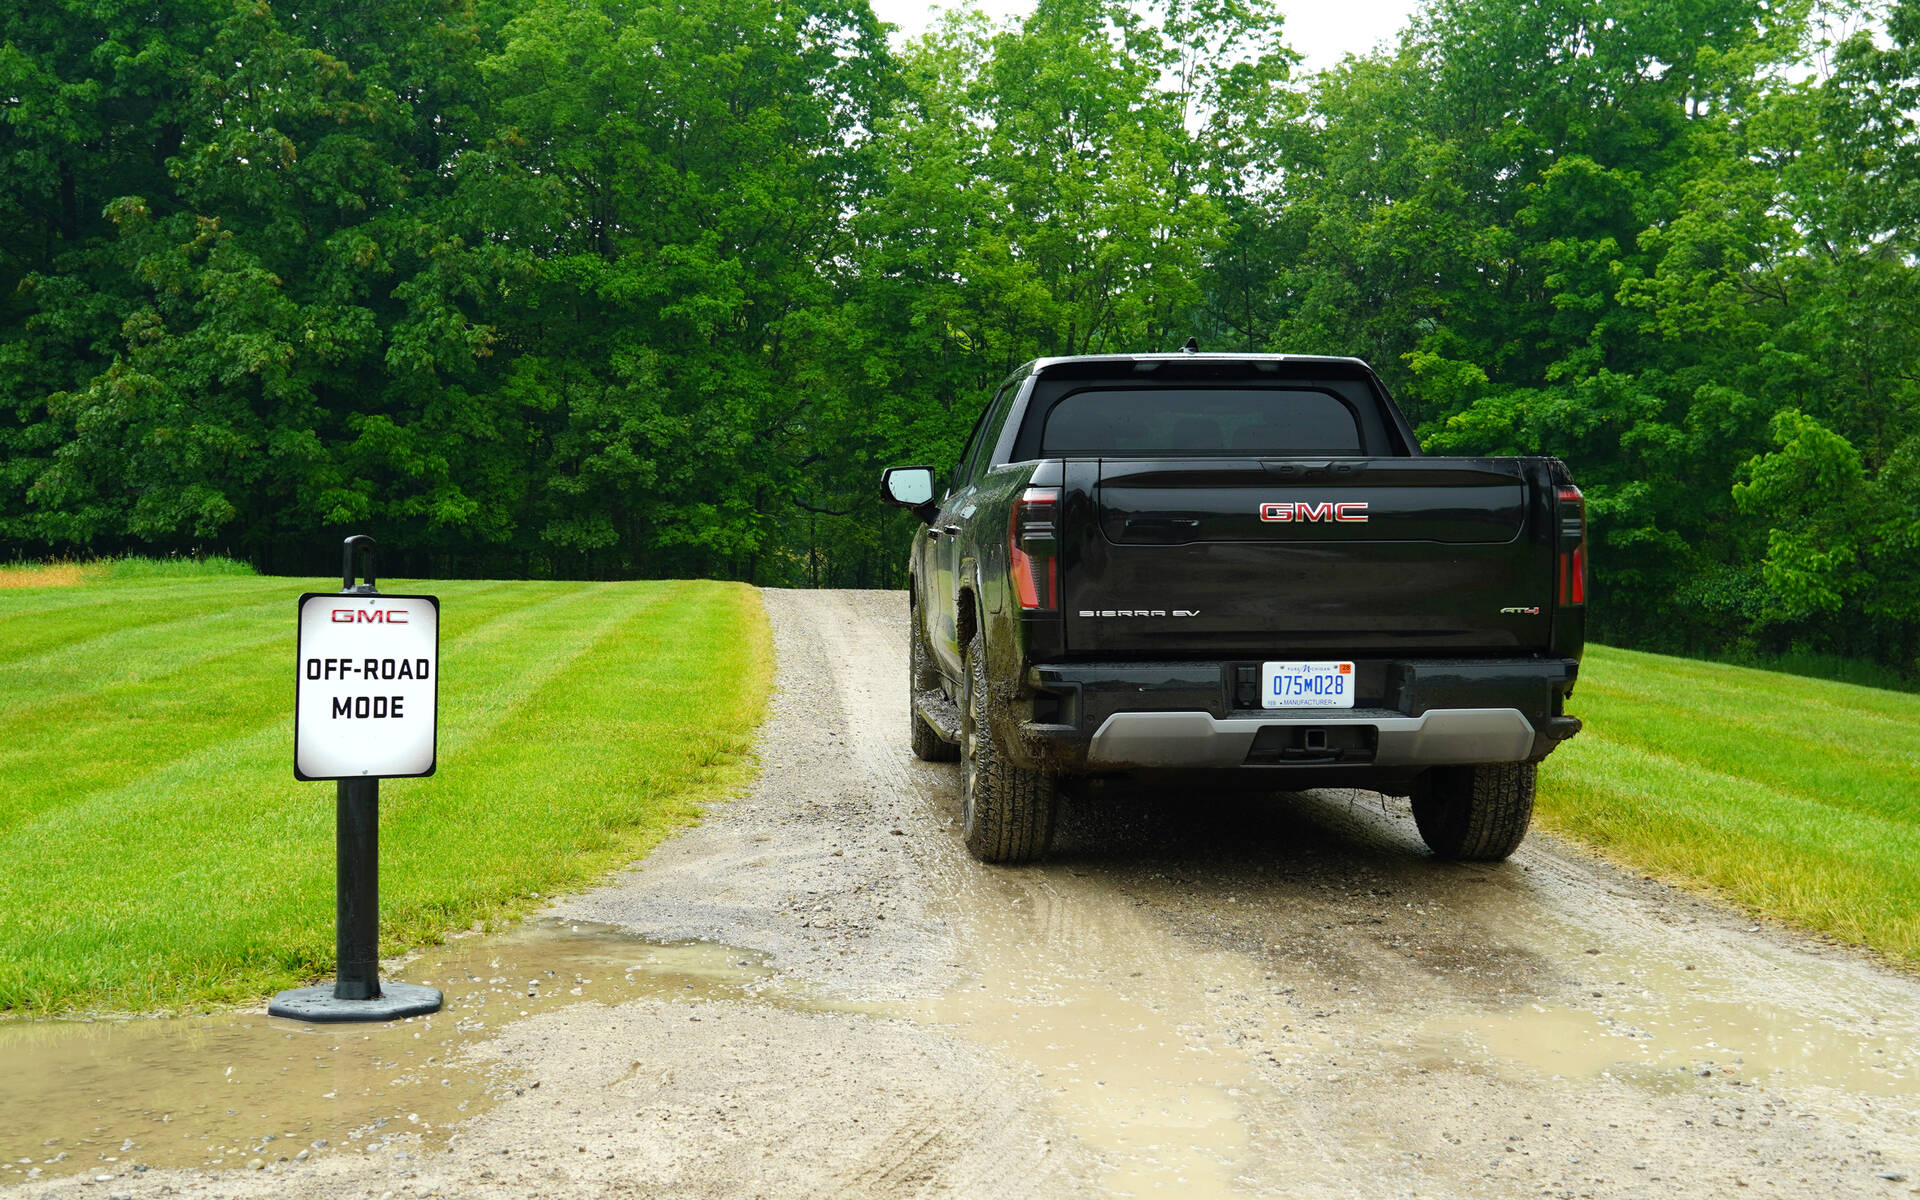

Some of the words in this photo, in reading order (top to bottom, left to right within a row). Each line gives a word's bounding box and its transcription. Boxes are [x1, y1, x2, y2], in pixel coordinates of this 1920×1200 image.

[1259, 502, 1369, 523] GMC
[331, 609, 410, 624] GMC
[1500, 607, 1540, 615] AT4
[306, 658, 430, 681] OFF-ROAD
[1273, 675, 1344, 696] 075M028
[331, 696, 405, 719] MODE
